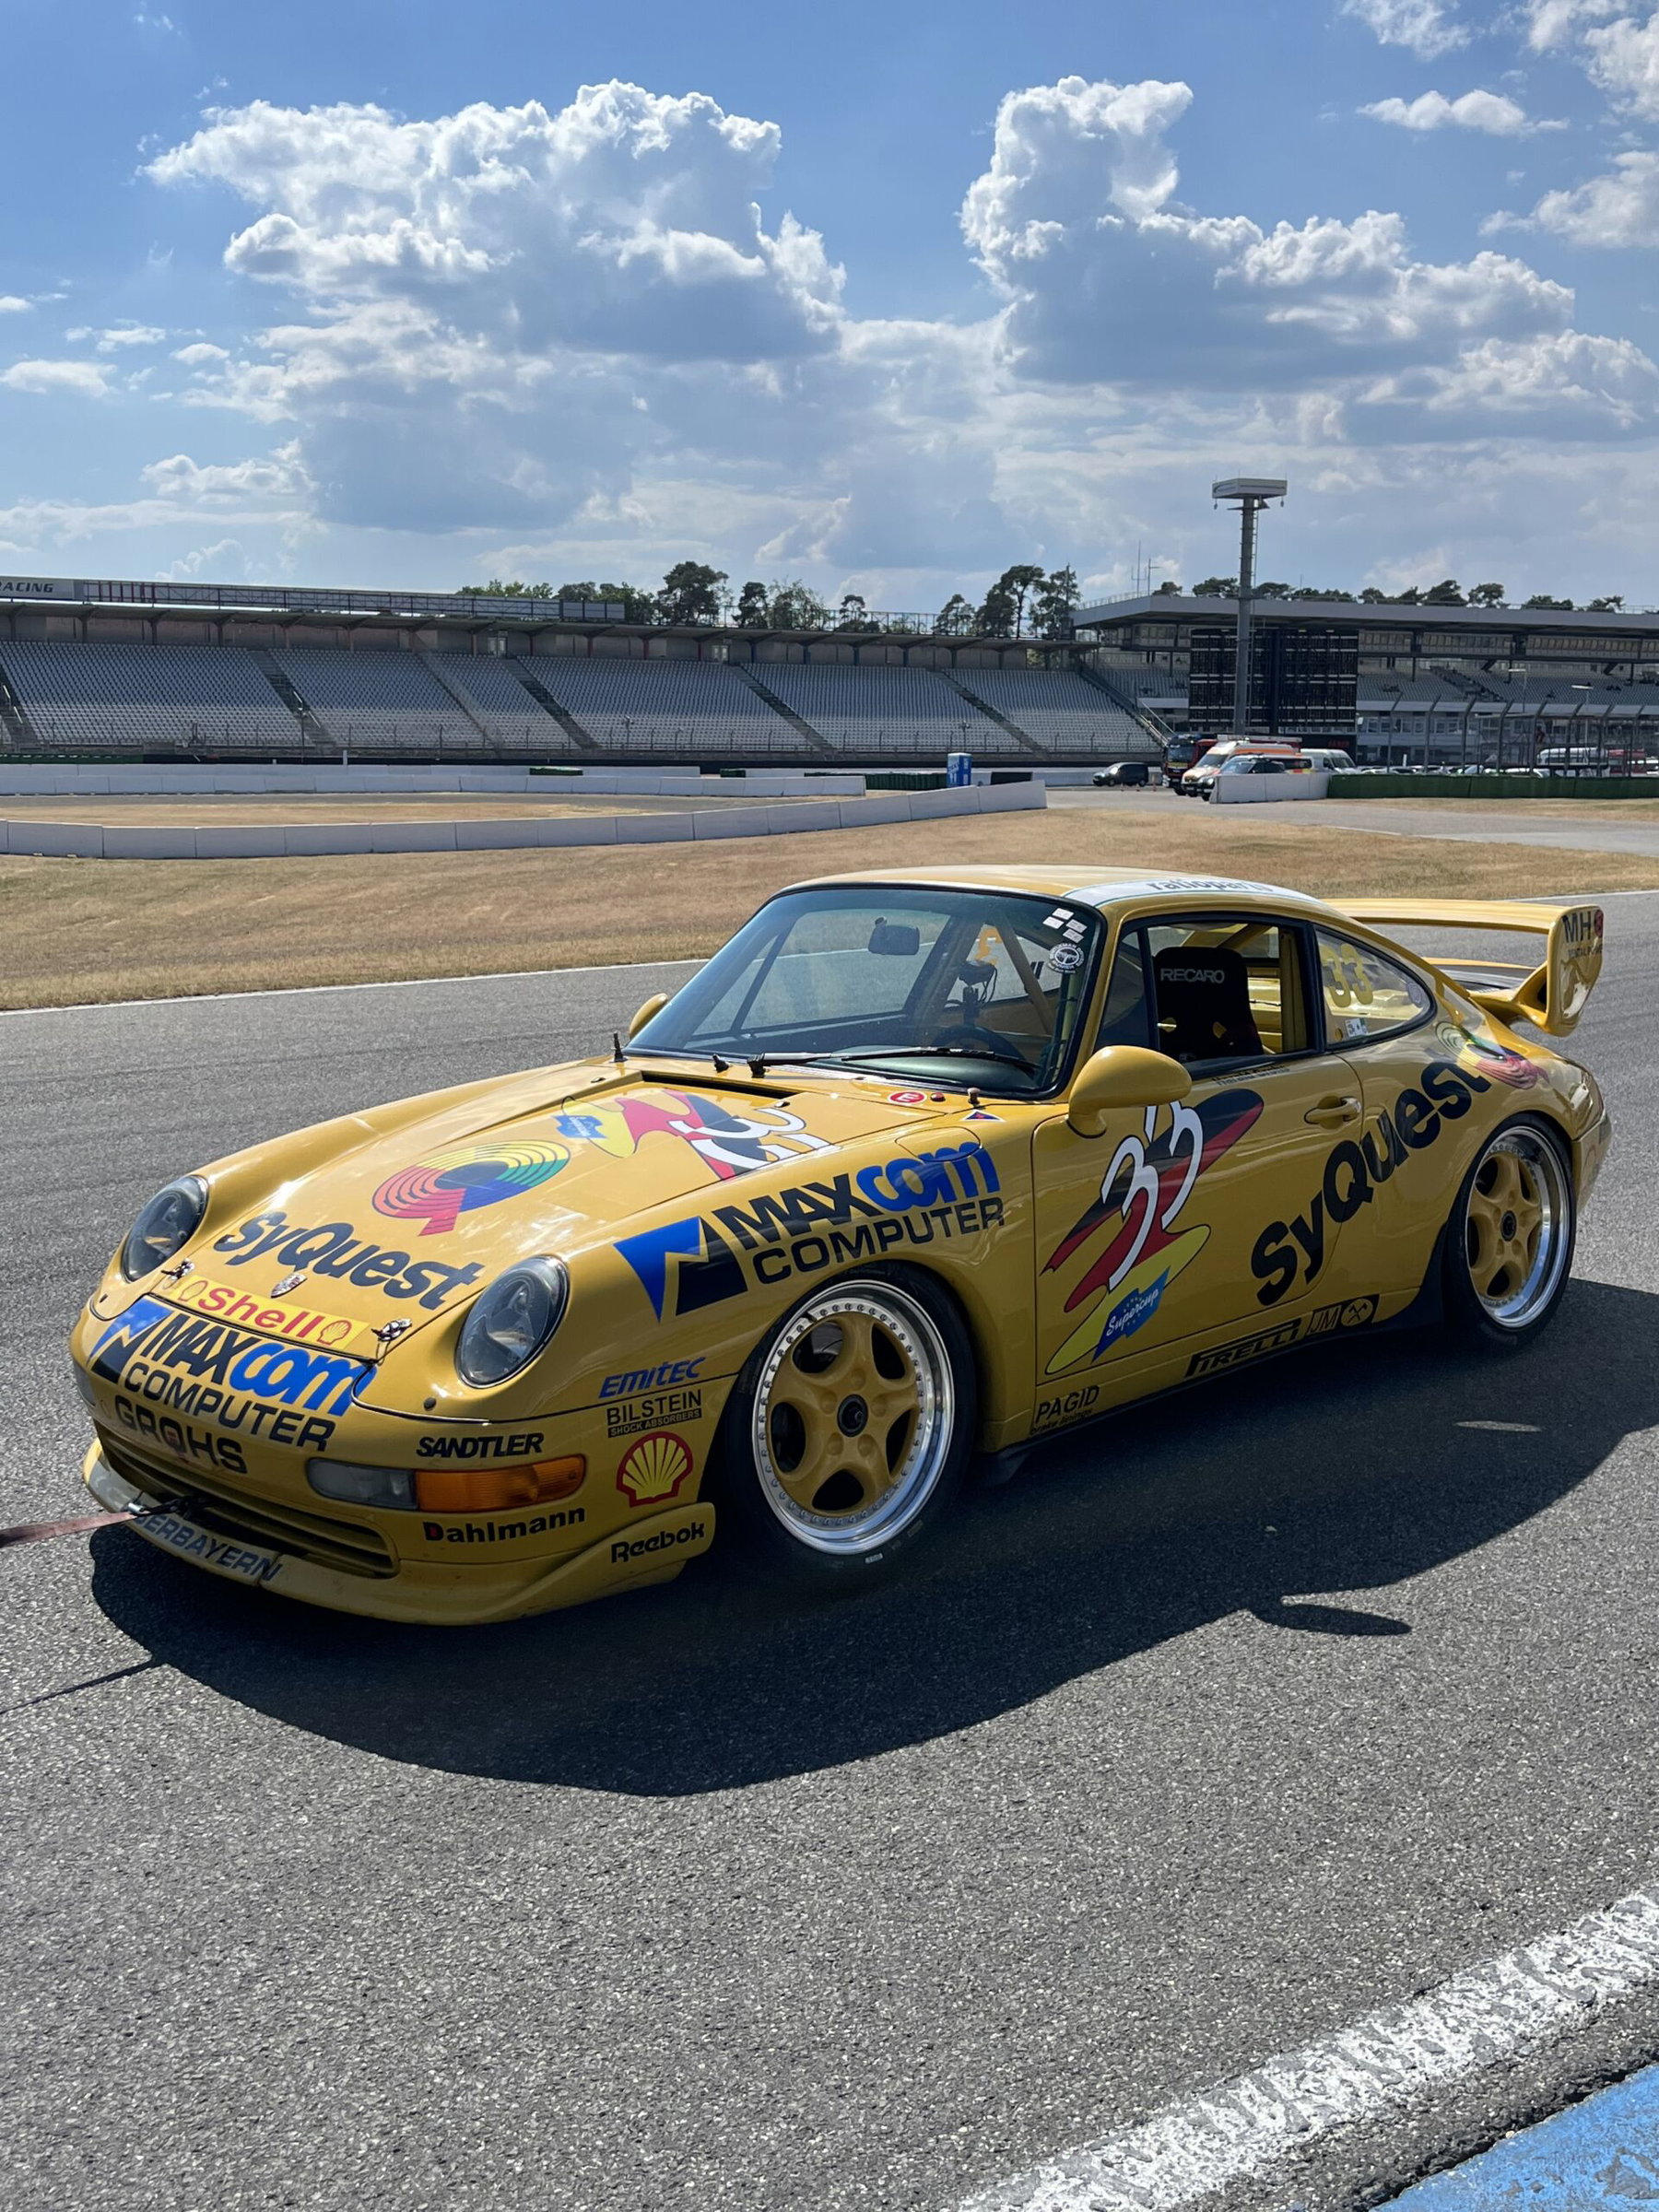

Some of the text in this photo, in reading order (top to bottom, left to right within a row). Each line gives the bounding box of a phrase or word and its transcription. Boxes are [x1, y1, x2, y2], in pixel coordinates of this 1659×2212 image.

[0, 582, 54, 593] ACING
[1159, 968, 1225, 984] RECARO
[1251, 1062, 1492, 1306] SyQuest
[213, 1211, 485, 1311] SyQuest
[752, 1196, 1006, 1285] COMPUTER
[197, 1287, 326, 1338] Shell
[1106, 1288, 1159, 1336] Supercup
[1183, 1316, 1302, 1379] PIRELLI
[124, 1361, 336, 1452] COMPUTER
[606, 1389, 702, 1427] BILSTEIN
[610, 1409, 700, 1437] SHOCK ABSORBERS
[1034, 1385, 1100, 1424] PAGID
[114, 1394, 248, 1475] GROHS
[416, 1432, 545, 1459] SANDTLER
[422, 1507, 586, 1544] Dahlmann
[610, 1522, 706, 1564] Reebok
